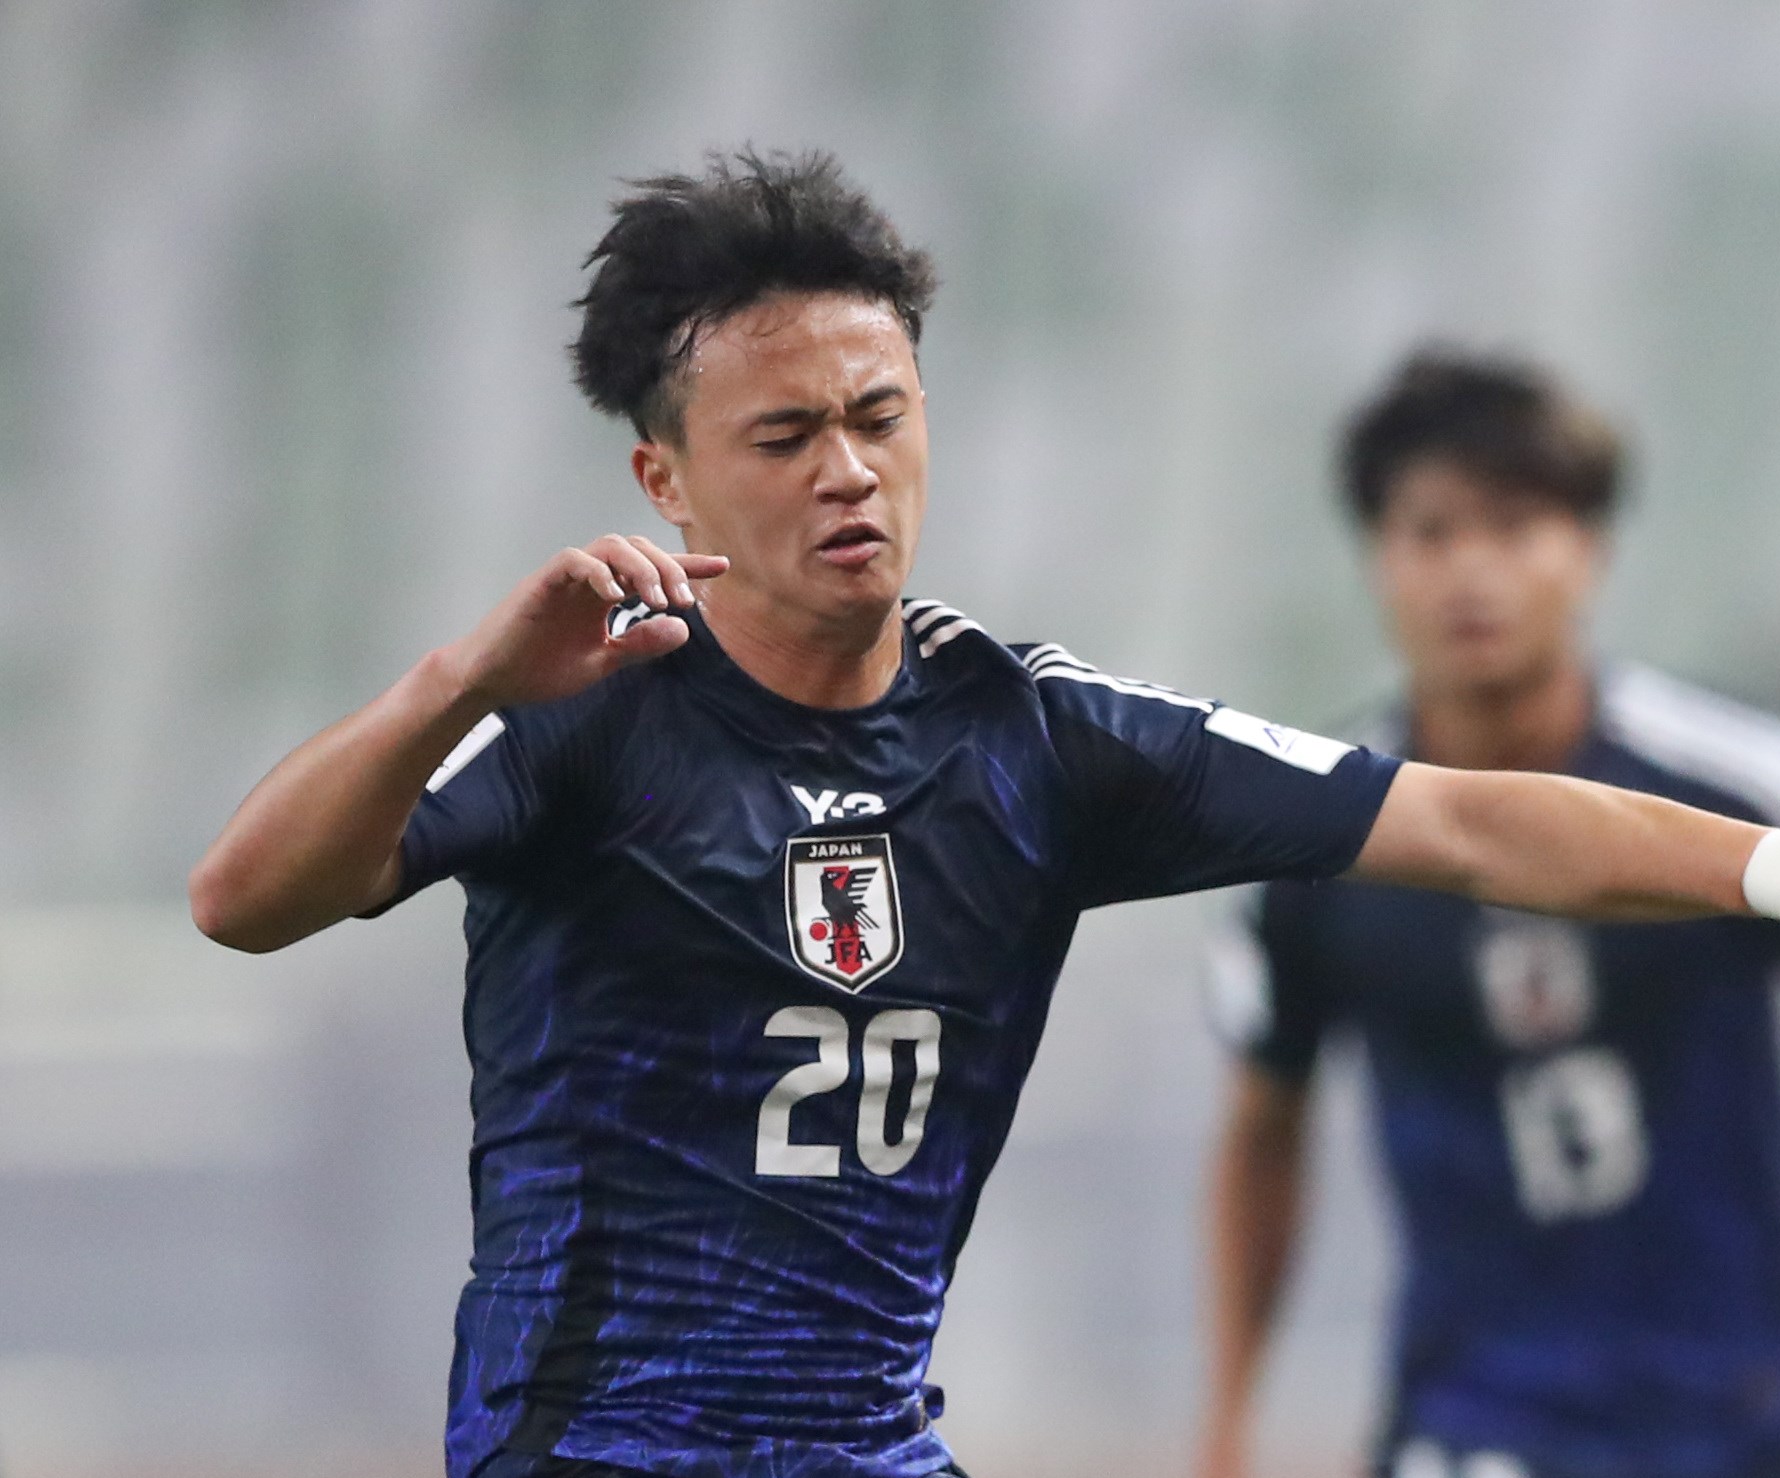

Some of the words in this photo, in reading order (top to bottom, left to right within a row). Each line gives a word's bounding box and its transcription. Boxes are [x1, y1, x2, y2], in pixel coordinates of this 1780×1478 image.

[808, 843, 864, 859] JAPAN
[824, 938, 873, 965] JFA
[755, 1005, 942, 1178] 20
